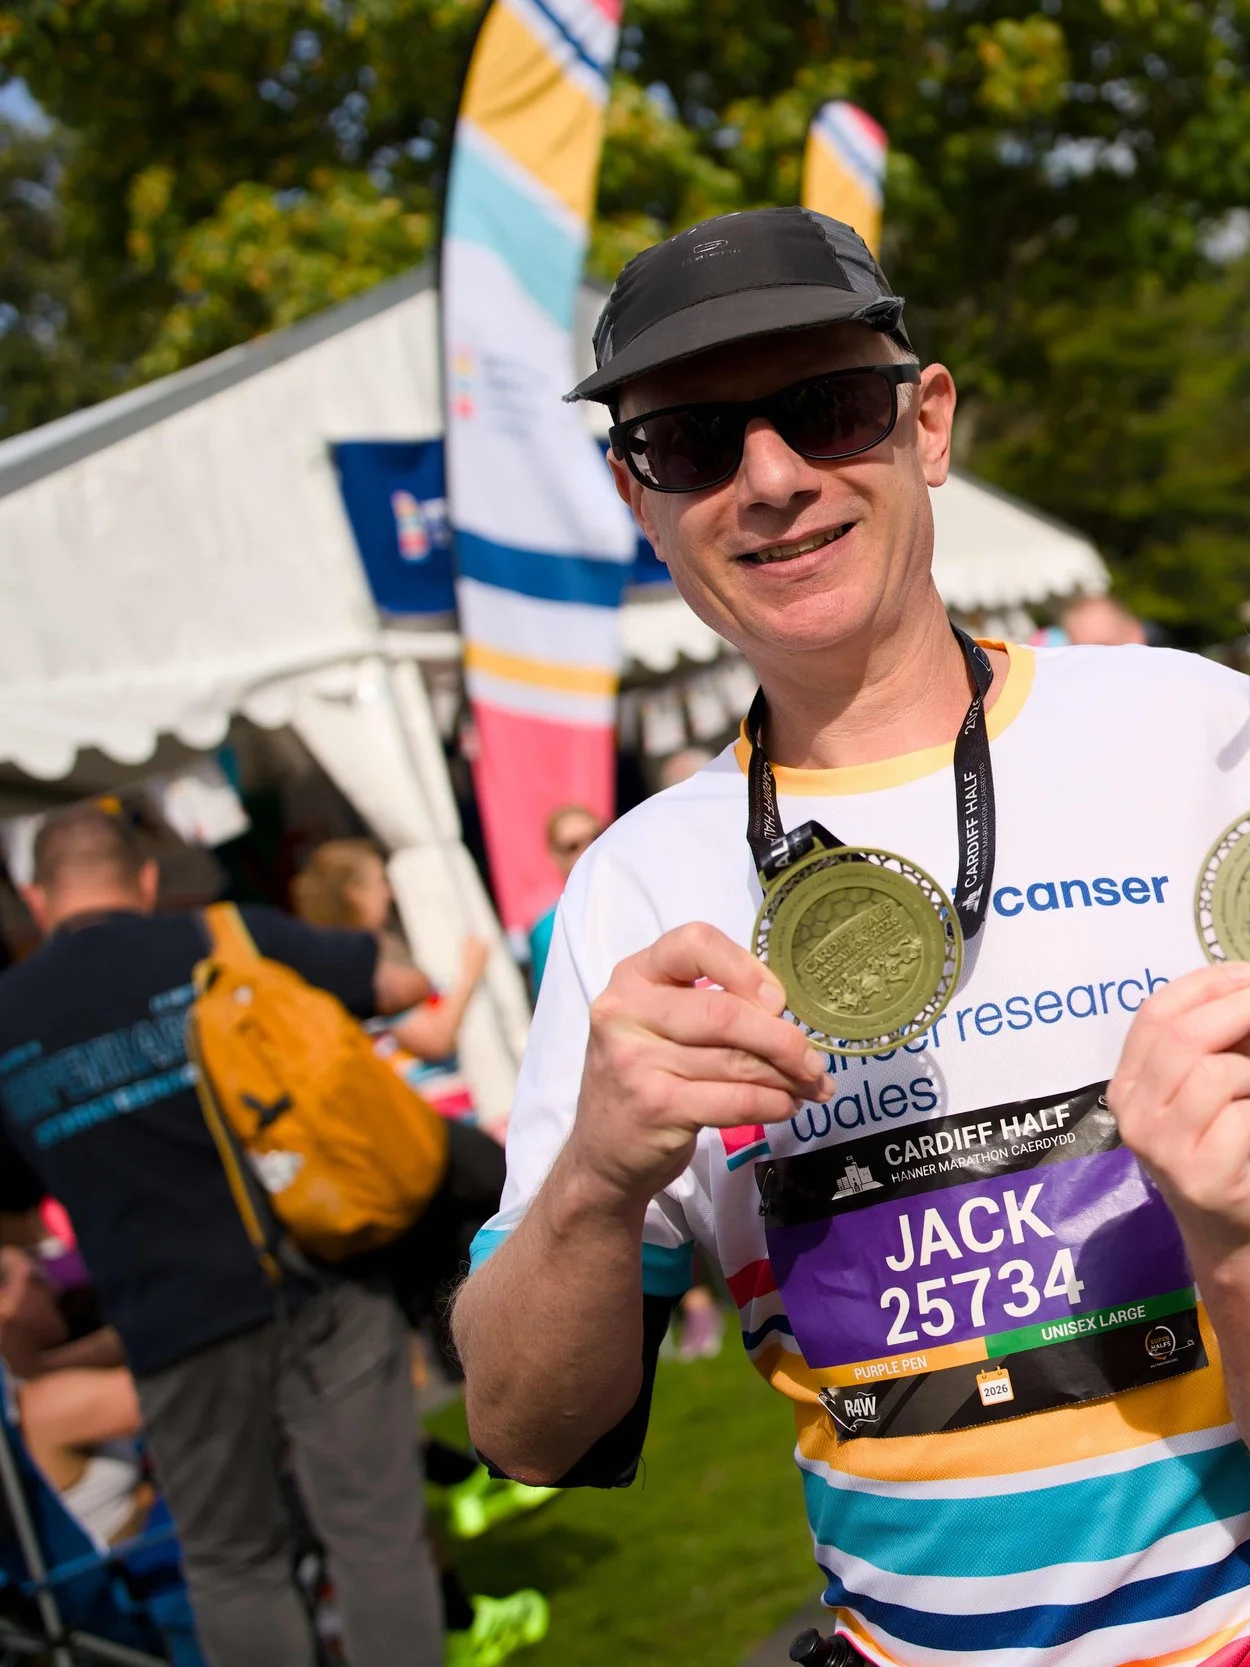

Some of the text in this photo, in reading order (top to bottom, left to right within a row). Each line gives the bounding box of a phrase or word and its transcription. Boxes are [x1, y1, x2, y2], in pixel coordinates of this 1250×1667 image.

[963, 771, 980, 888] CARDIFF HALF
[980, 802, 989, 846] MARATHON
[992, 875, 1169, 917] canser
[790, 1076, 938, 1142] wales
[884, 1104, 1071, 1166] CARDIFF HALF
[891, 1132, 1076, 1184] HANNER MARATHON CAERDYDD
[885, 1183, 1056, 1272] JACK
[880, 1247, 1085, 1346] 25734
[1041, 1305, 1146, 1341] UNISEX LARGE
[854, 1355, 928, 1381] PURPLE PEN
[983, 1383, 1009, 1398] 2026
[844, 1396, 877, 1418] R4W
